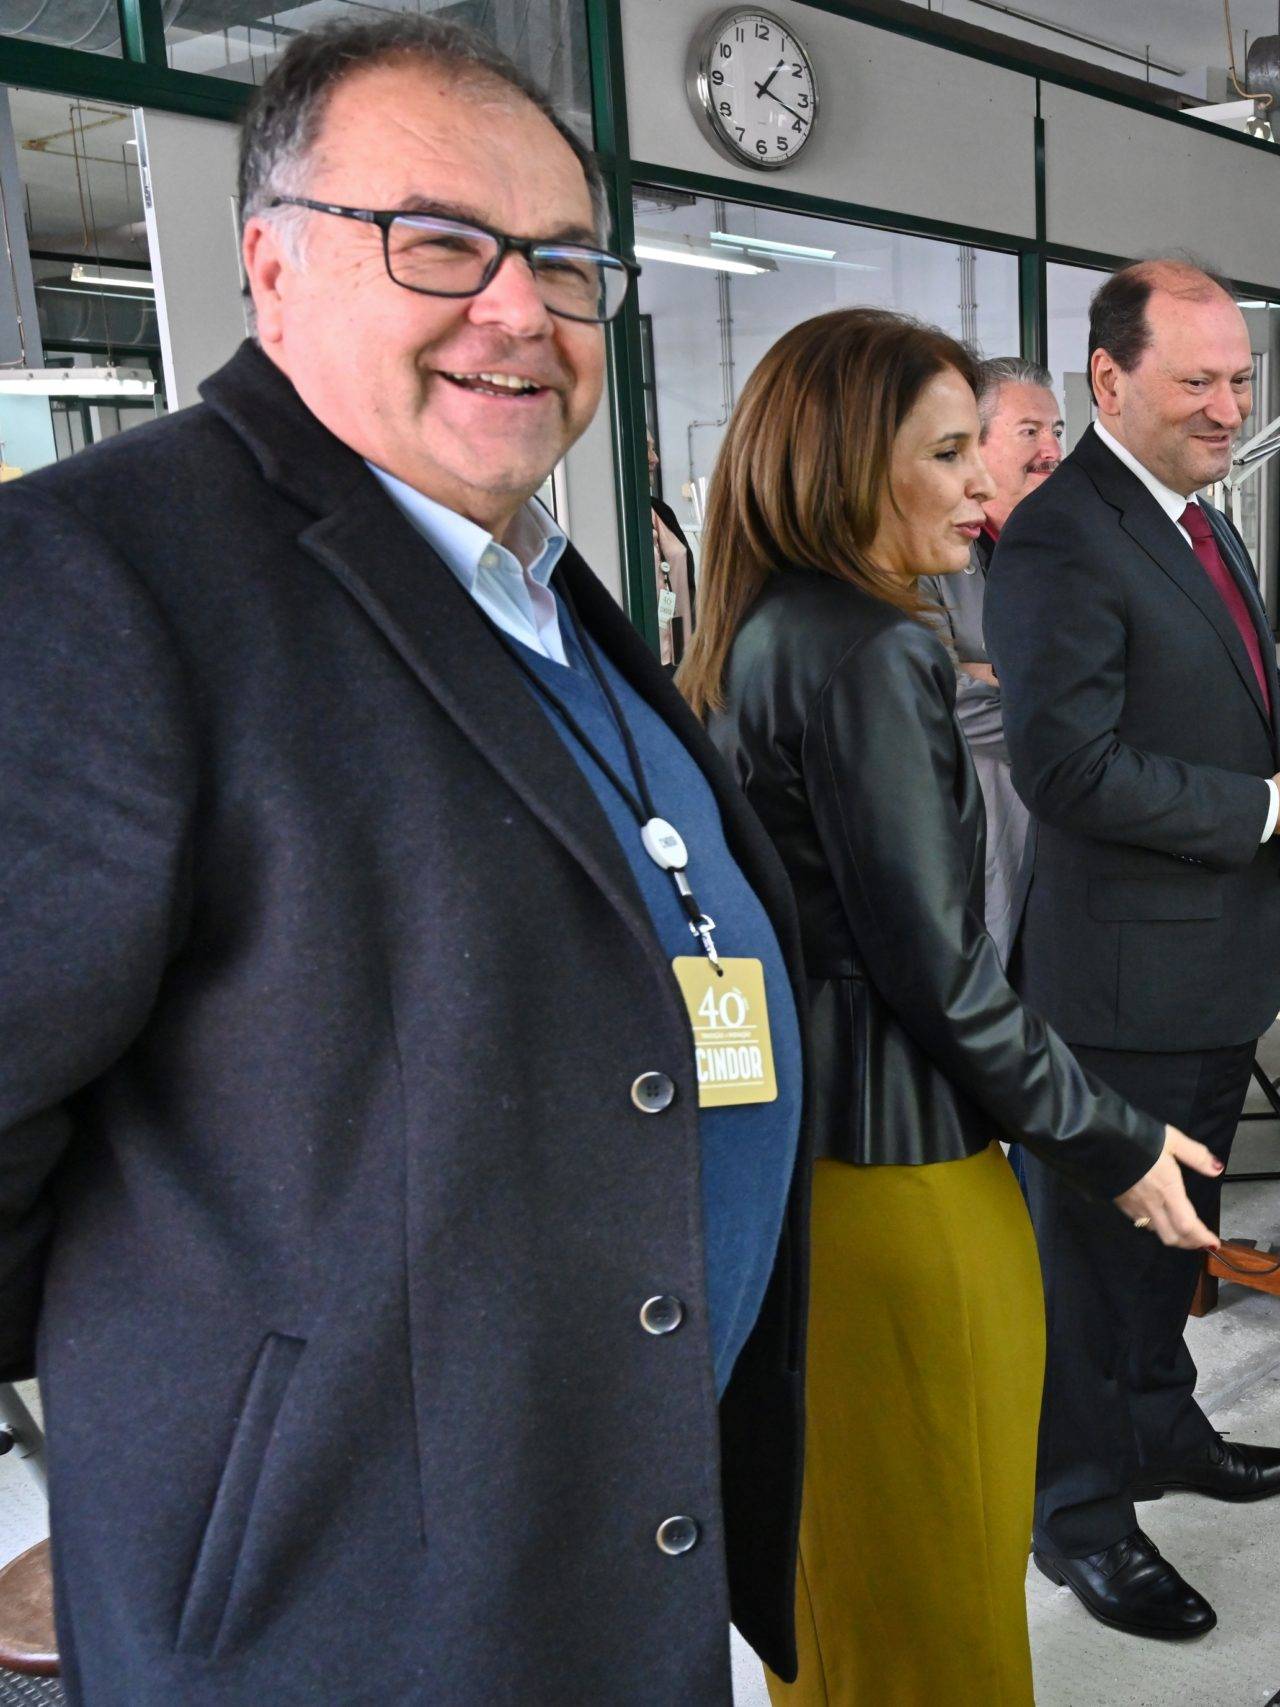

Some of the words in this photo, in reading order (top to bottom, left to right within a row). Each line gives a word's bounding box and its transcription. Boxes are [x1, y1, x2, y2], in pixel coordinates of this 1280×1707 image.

[735, 27, 744, 43] 11
[755, 23, 770, 41] 12
[720, 43, 732, 59] 10
[711, 70, 724, 86] 9
[792, 63, 803, 78] 2
[797, 93, 809, 109] 3
[720, 102, 732, 117] 8
[735, 126, 746, 142] 7
[791, 119, 802, 134] 4
[756, 139, 768, 155] 6
[777, 136, 788, 151] 5
[698, 986, 746, 1028] 40
[695, 1045, 764, 1083] CINDOR
